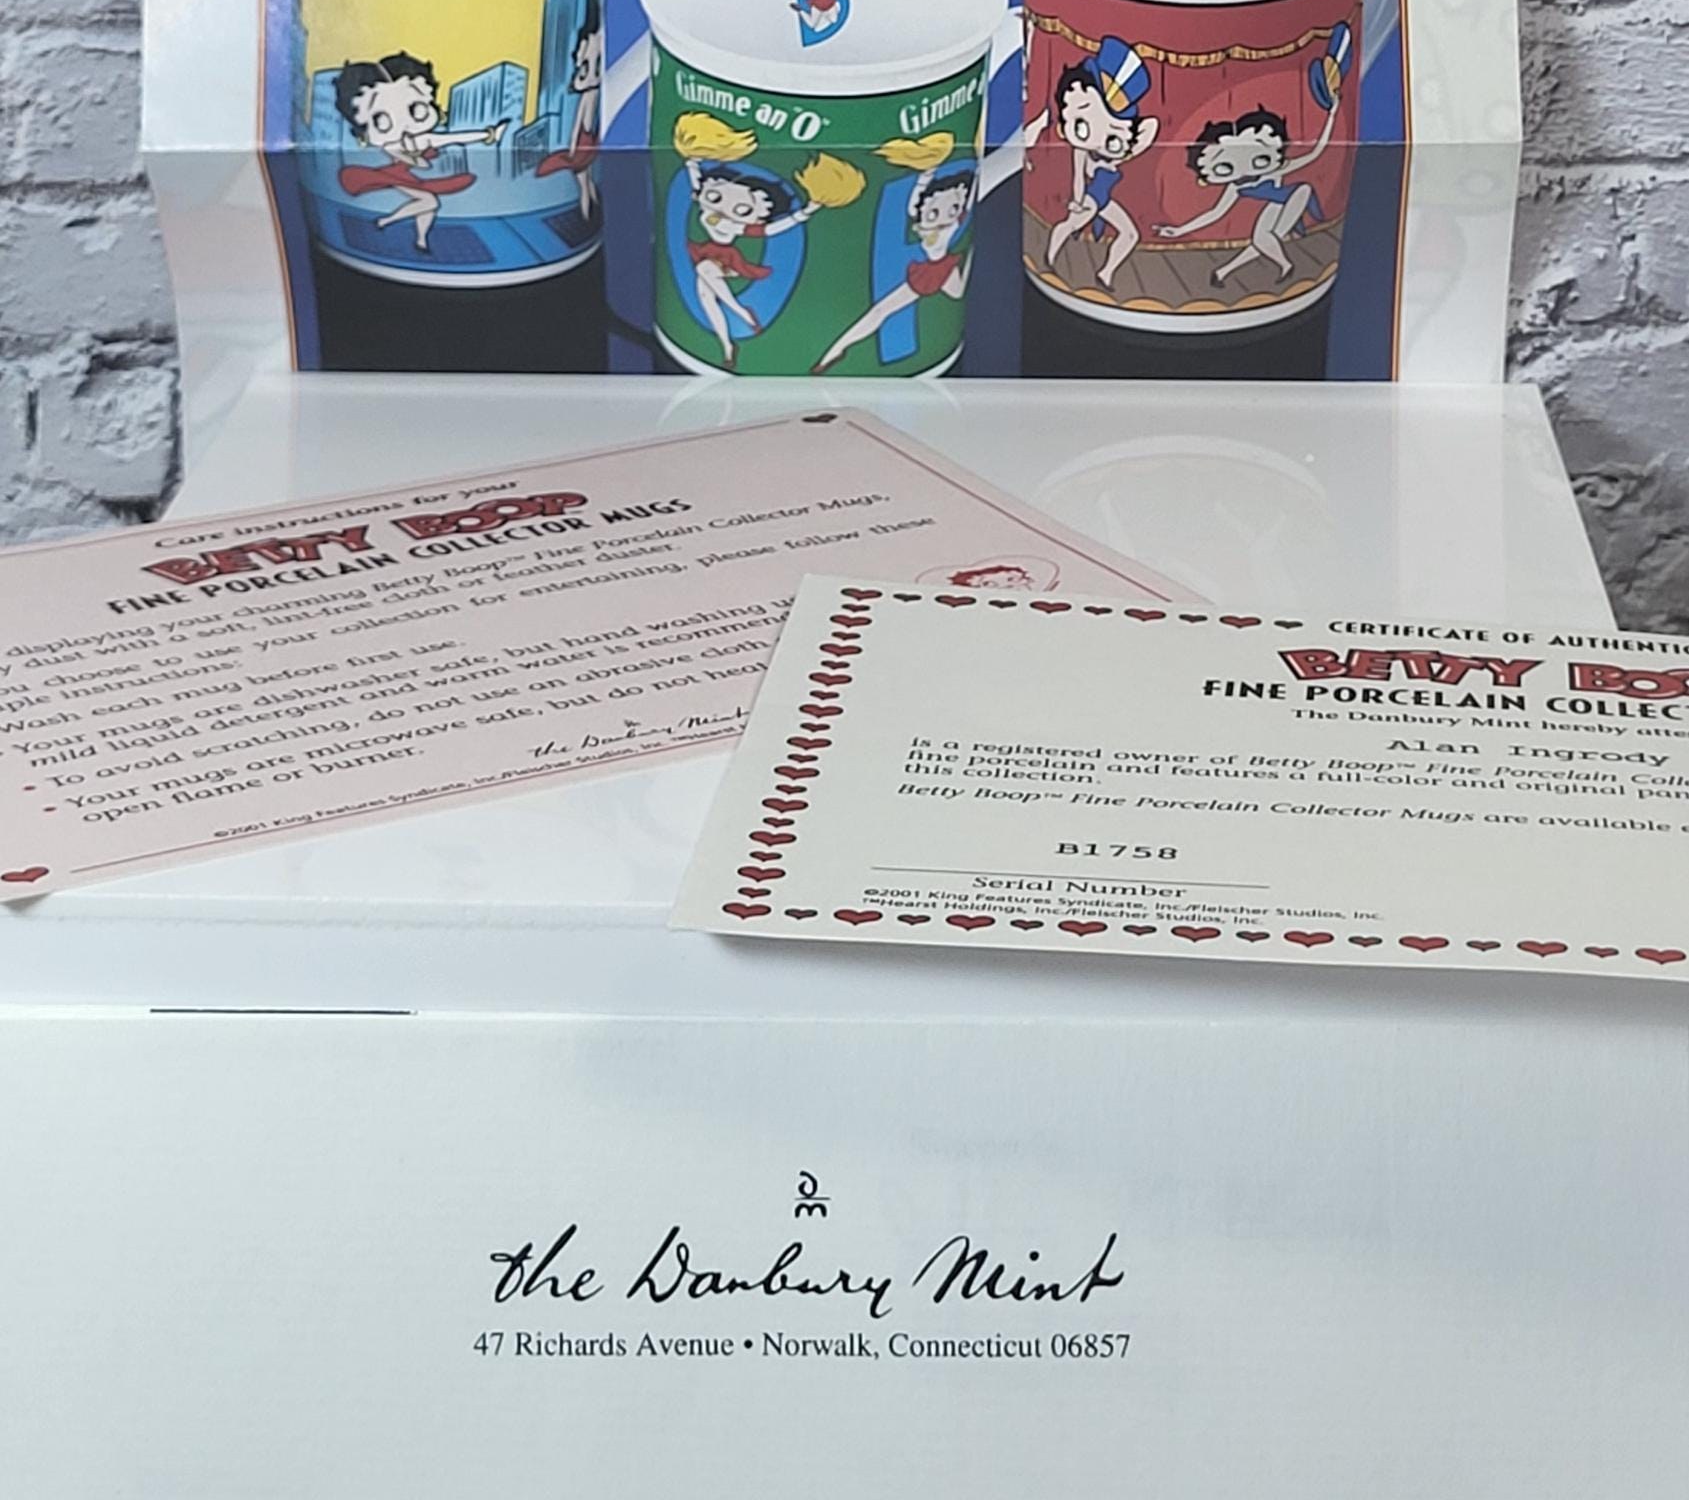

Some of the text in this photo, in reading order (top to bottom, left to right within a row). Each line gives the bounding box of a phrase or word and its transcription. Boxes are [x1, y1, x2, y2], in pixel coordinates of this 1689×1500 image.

[675, 70, 751, 117] Gimme
[754, 102, 788, 131] an
[898, 79, 978, 135] Gimme
[140, 491, 589, 586] BETTY BOOP
[154, 481, 517, 548] Care instructions for your
[106, 498, 692, 615] FINE PORCELAIN COLLECTOR MUGS
[43, 517, 935, 687] choose to use your collection for entertaining, please follow these
[1328, 621, 1689, 655] CERTIFICATE OF AUTHENTI
[0, 712, 82, 734] Wash
[91, 696, 163, 716] each
[172, 682, 243, 702] mug
[245, 663, 338, 685] before
[346, 650, 403, 667] first
[11, 604, 767, 754] Your mugs are dishwasher safe, but hand washing
[1277, 648, 1545, 688] BETTY
[30, 745, 97, 768] mild
[106, 725, 201, 752] liquid
[210, 696, 351, 731] detergent
[359, 682, 419, 701] and
[425, 666, 511, 688] warm
[517, 650, 597, 670] water
[606, 645, 630, 655] is
[47, 640, 770, 788] To avoid scratching, do not use an abrasive cloth
[1203, 679, 1689, 721] FINE PORCELAIN COLLEC
[1296, 709, 1627, 736] The Danbury Mint hereby
[65, 787, 138, 809] Your
[151, 768, 238, 792] mugs
[246, 755, 295, 771] are
[304, 720, 467, 760] microwave
[475, 708, 543, 724] safe,
[549, 694, 601, 710] but
[608, 686, 644, 699] do
[651, 674, 701, 691] not
[911, 737, 931, 748] is
[943, 742, 959, 750] a
[972, 743, 1102, 759] registered
[1113, 752, 1199, 764] owner
[1209, 755, 1237, 765] of
[1249, 755, 1315, 770] Betty
[1426, 763, 1481, 775] Fine
[1494, 766, 1617, 783] Porcelain
[1387, 740, 1669, 767] Alan Ingrody
[82, 746, 424, 823] open flame or burner.
[904, 763, 1101, 784] this collection.
[908, 750, 959, 762] fine
[968, 755, 1095, 771] porcelain
[1106, 764, 1160, 775] and
[1171, 765, 1279, 780] features
[1289, 772, 1305, 781] a
[1317, 771, 1442, 786] full-color
[1451, 778, 1505, 789] and
[1515, 782, 1625, 796] original
[898, 783, 965, 800] Betty
[1070, 793, 1126, 806] Fine
[1136, 797, 1259, 812] Porcelain
[1270, 803, 1391, 818] Collector
[1400, 808, 1474, 823] Mugs
[1484, 814, 1528, 824] are
[1538, 817, 1671, 831] available
[1056, 842, 1177, 860] B1758
[928, 891, 969, 902] King
[975, 893, 1051, 905] Features
[1058, 897, 1147, 911] Syndicate,
[1275, 907, 1346, 920] Studios,
[972, 877, 1186, 898] Serial Number
[625, 1225, 893, 1319] Danbury
[912, 1231, 1126, 1303] Mint
[473, 1331, 1132, 1362] 47 Richards Avenue Norwalk, Connecticut 06857
